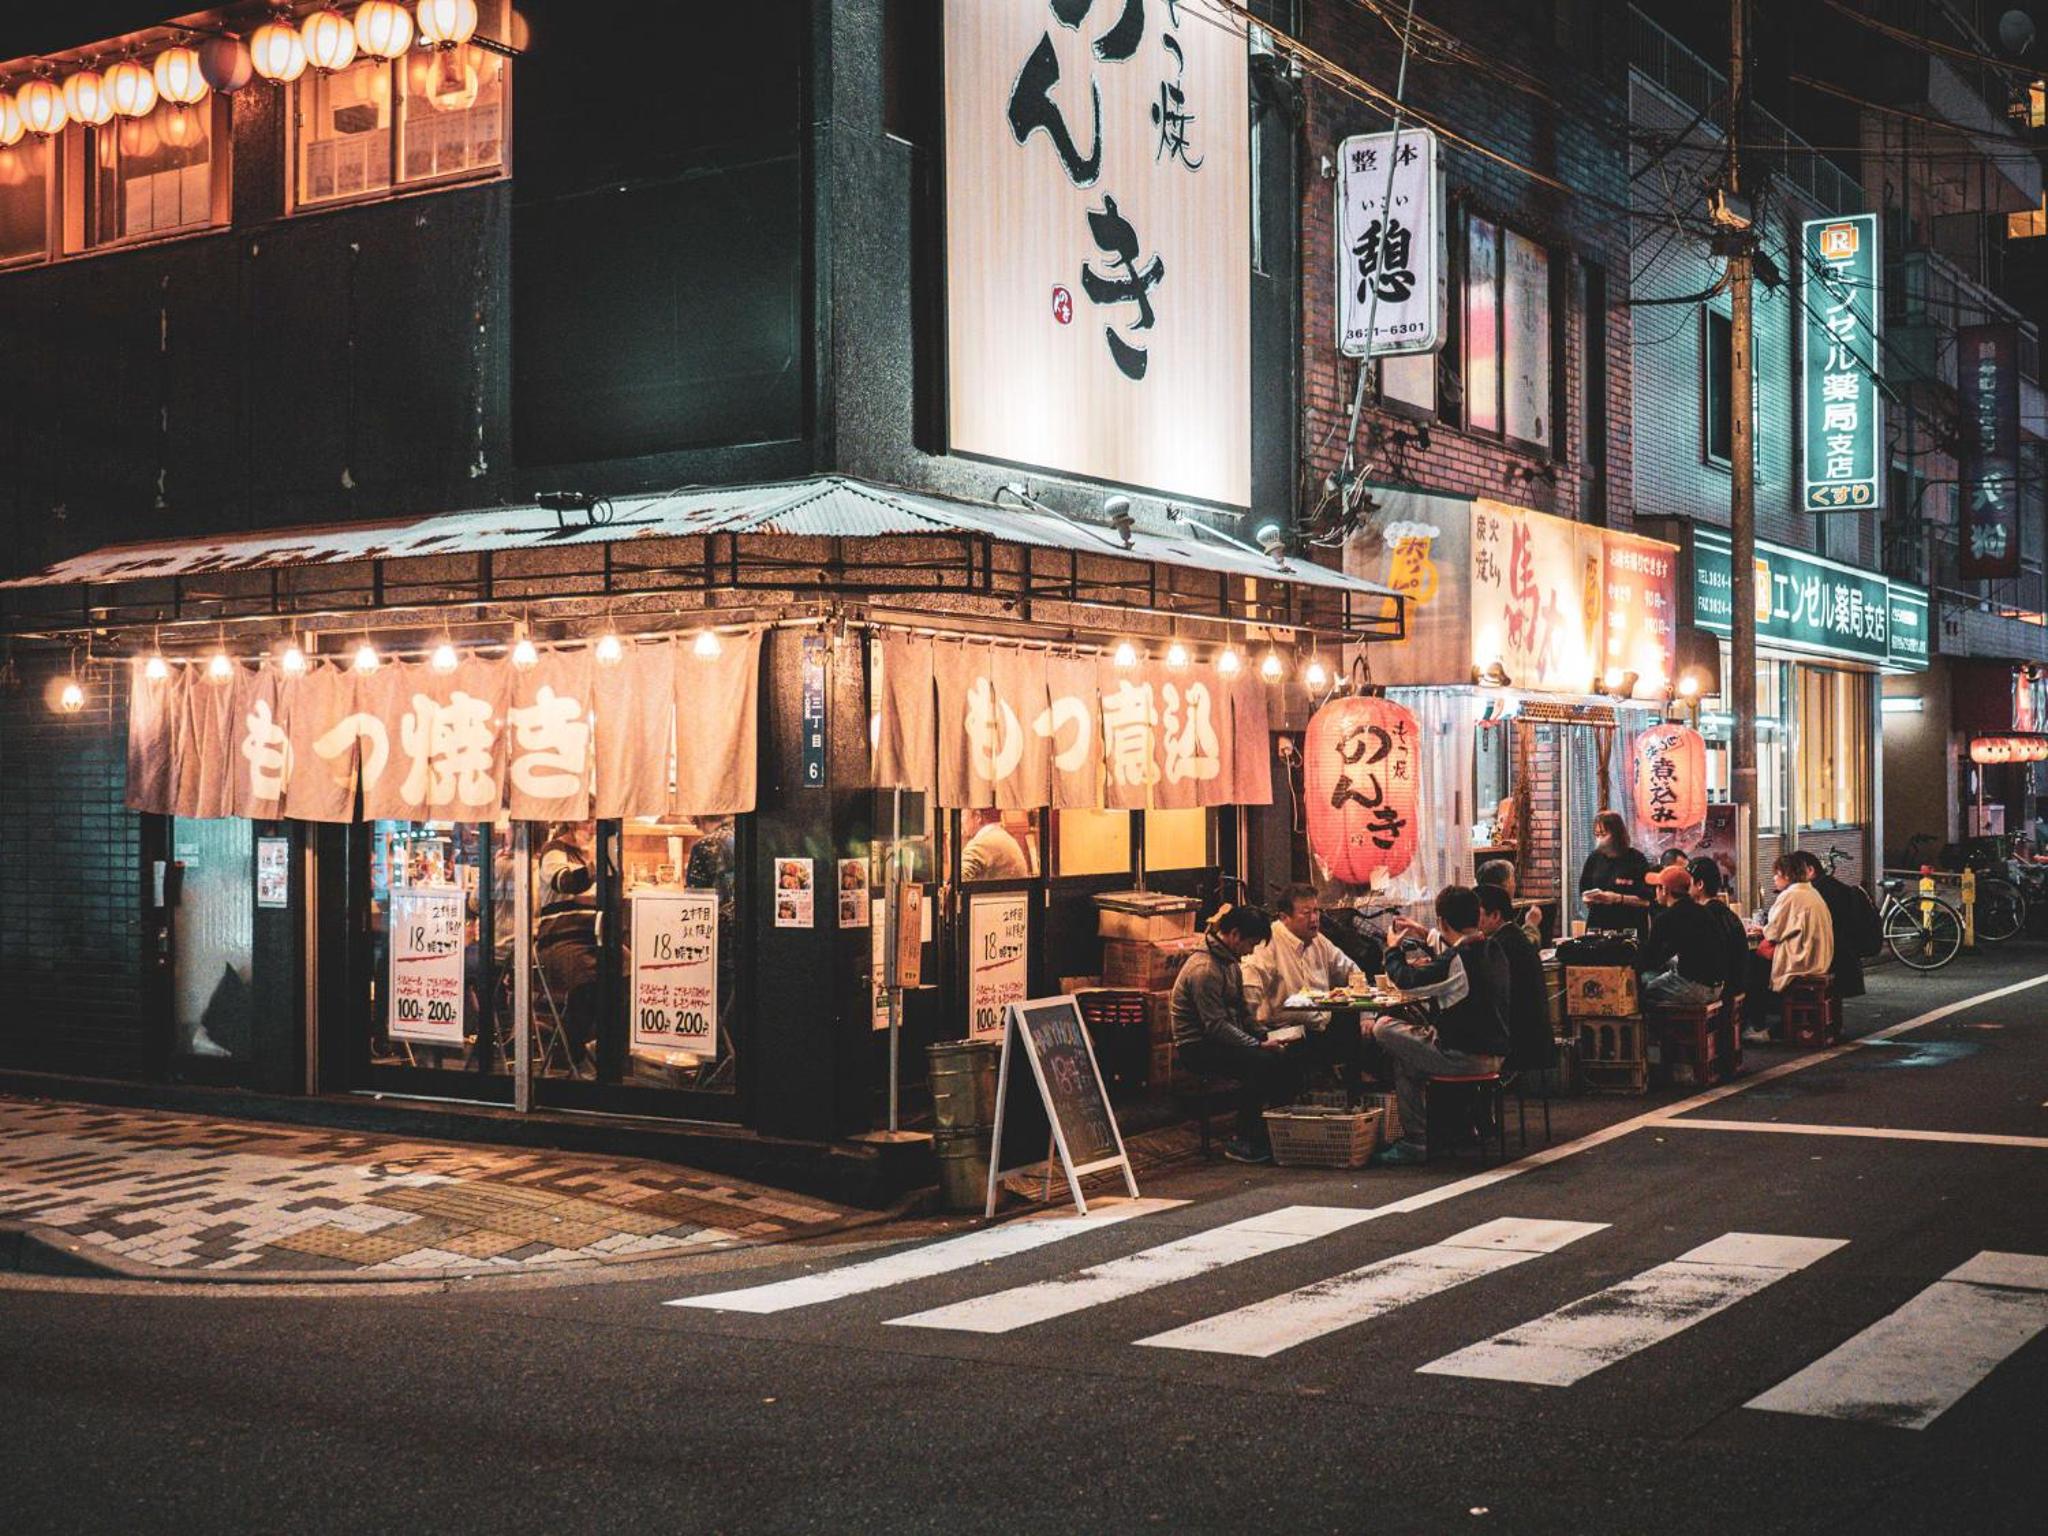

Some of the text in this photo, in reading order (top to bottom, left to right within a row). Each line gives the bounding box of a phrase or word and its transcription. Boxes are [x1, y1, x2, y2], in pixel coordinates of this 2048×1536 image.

[1353, 219, 1416, 304] 憩
[1811, 483, 1869, 506] くすり
[1774, 573, 1885, 643] エンゼル薬局支店
[241, 684, 588, 807] もつ焼き
[963, 676, 1221, 786] もつ煮込
[808, 762, 818, 779] 6
[1331, 725, 1407, 850] のんき
[1650, 757, 1677, 822] 煮込み
